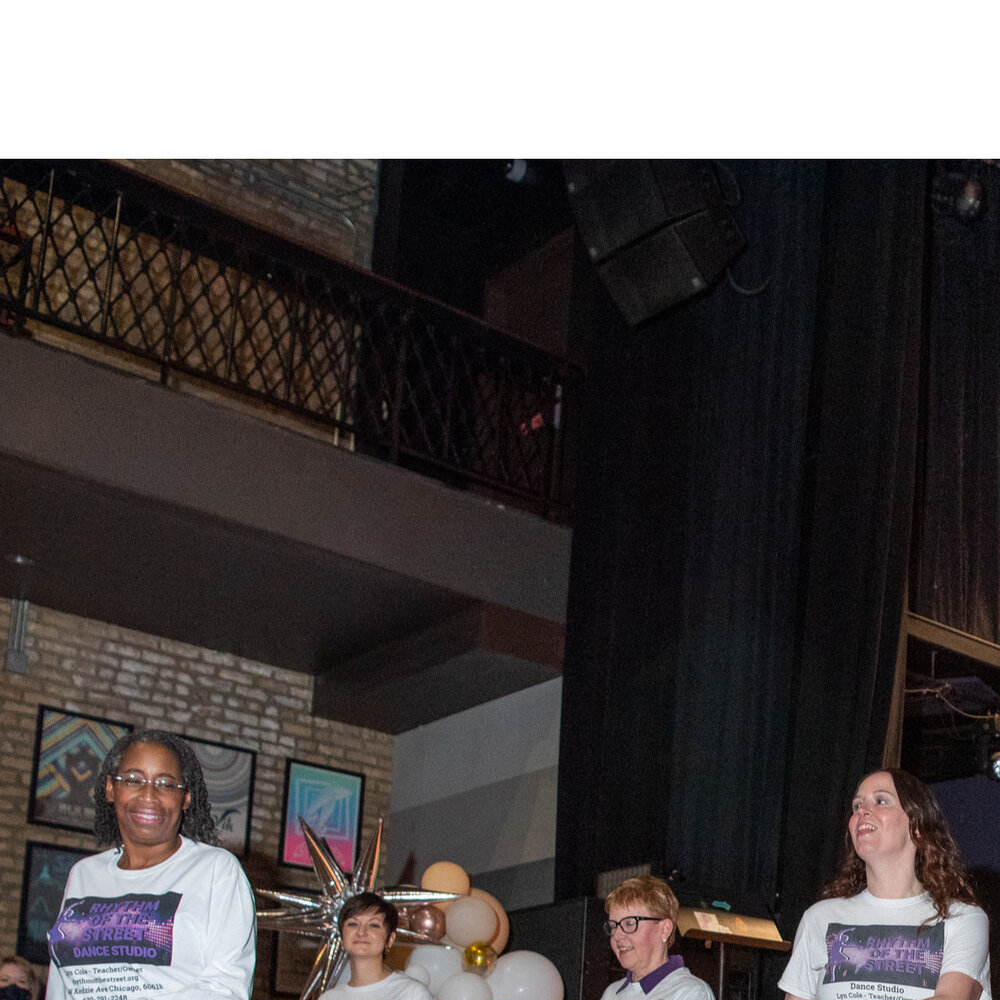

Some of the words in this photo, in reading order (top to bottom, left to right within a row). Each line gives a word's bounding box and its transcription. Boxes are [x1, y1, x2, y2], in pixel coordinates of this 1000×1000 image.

[90, 901, 160, 914] RHYTHM
[91, 913, 112, 926] OF
[118, 912, 150, 925] THE
[82, 927, 150, 941] STREET
[866, 937, 930, 949] RHYTHM
[73, 946, 110, 958] DANCE
[111, 946, 158, 958] STUDIO
[869, 949, 891, 959] OF
[894, 949, 925, 960] THE
[864, 960, 926, 975] STREET
[96, 985, 108, 994] Ave
[108, 983, 142, 994] Chicago,
[850, 982, 875, 990] Dance
[877, 984, 905, 994] Studio
[836, 992, 847, 1000] Lyn
